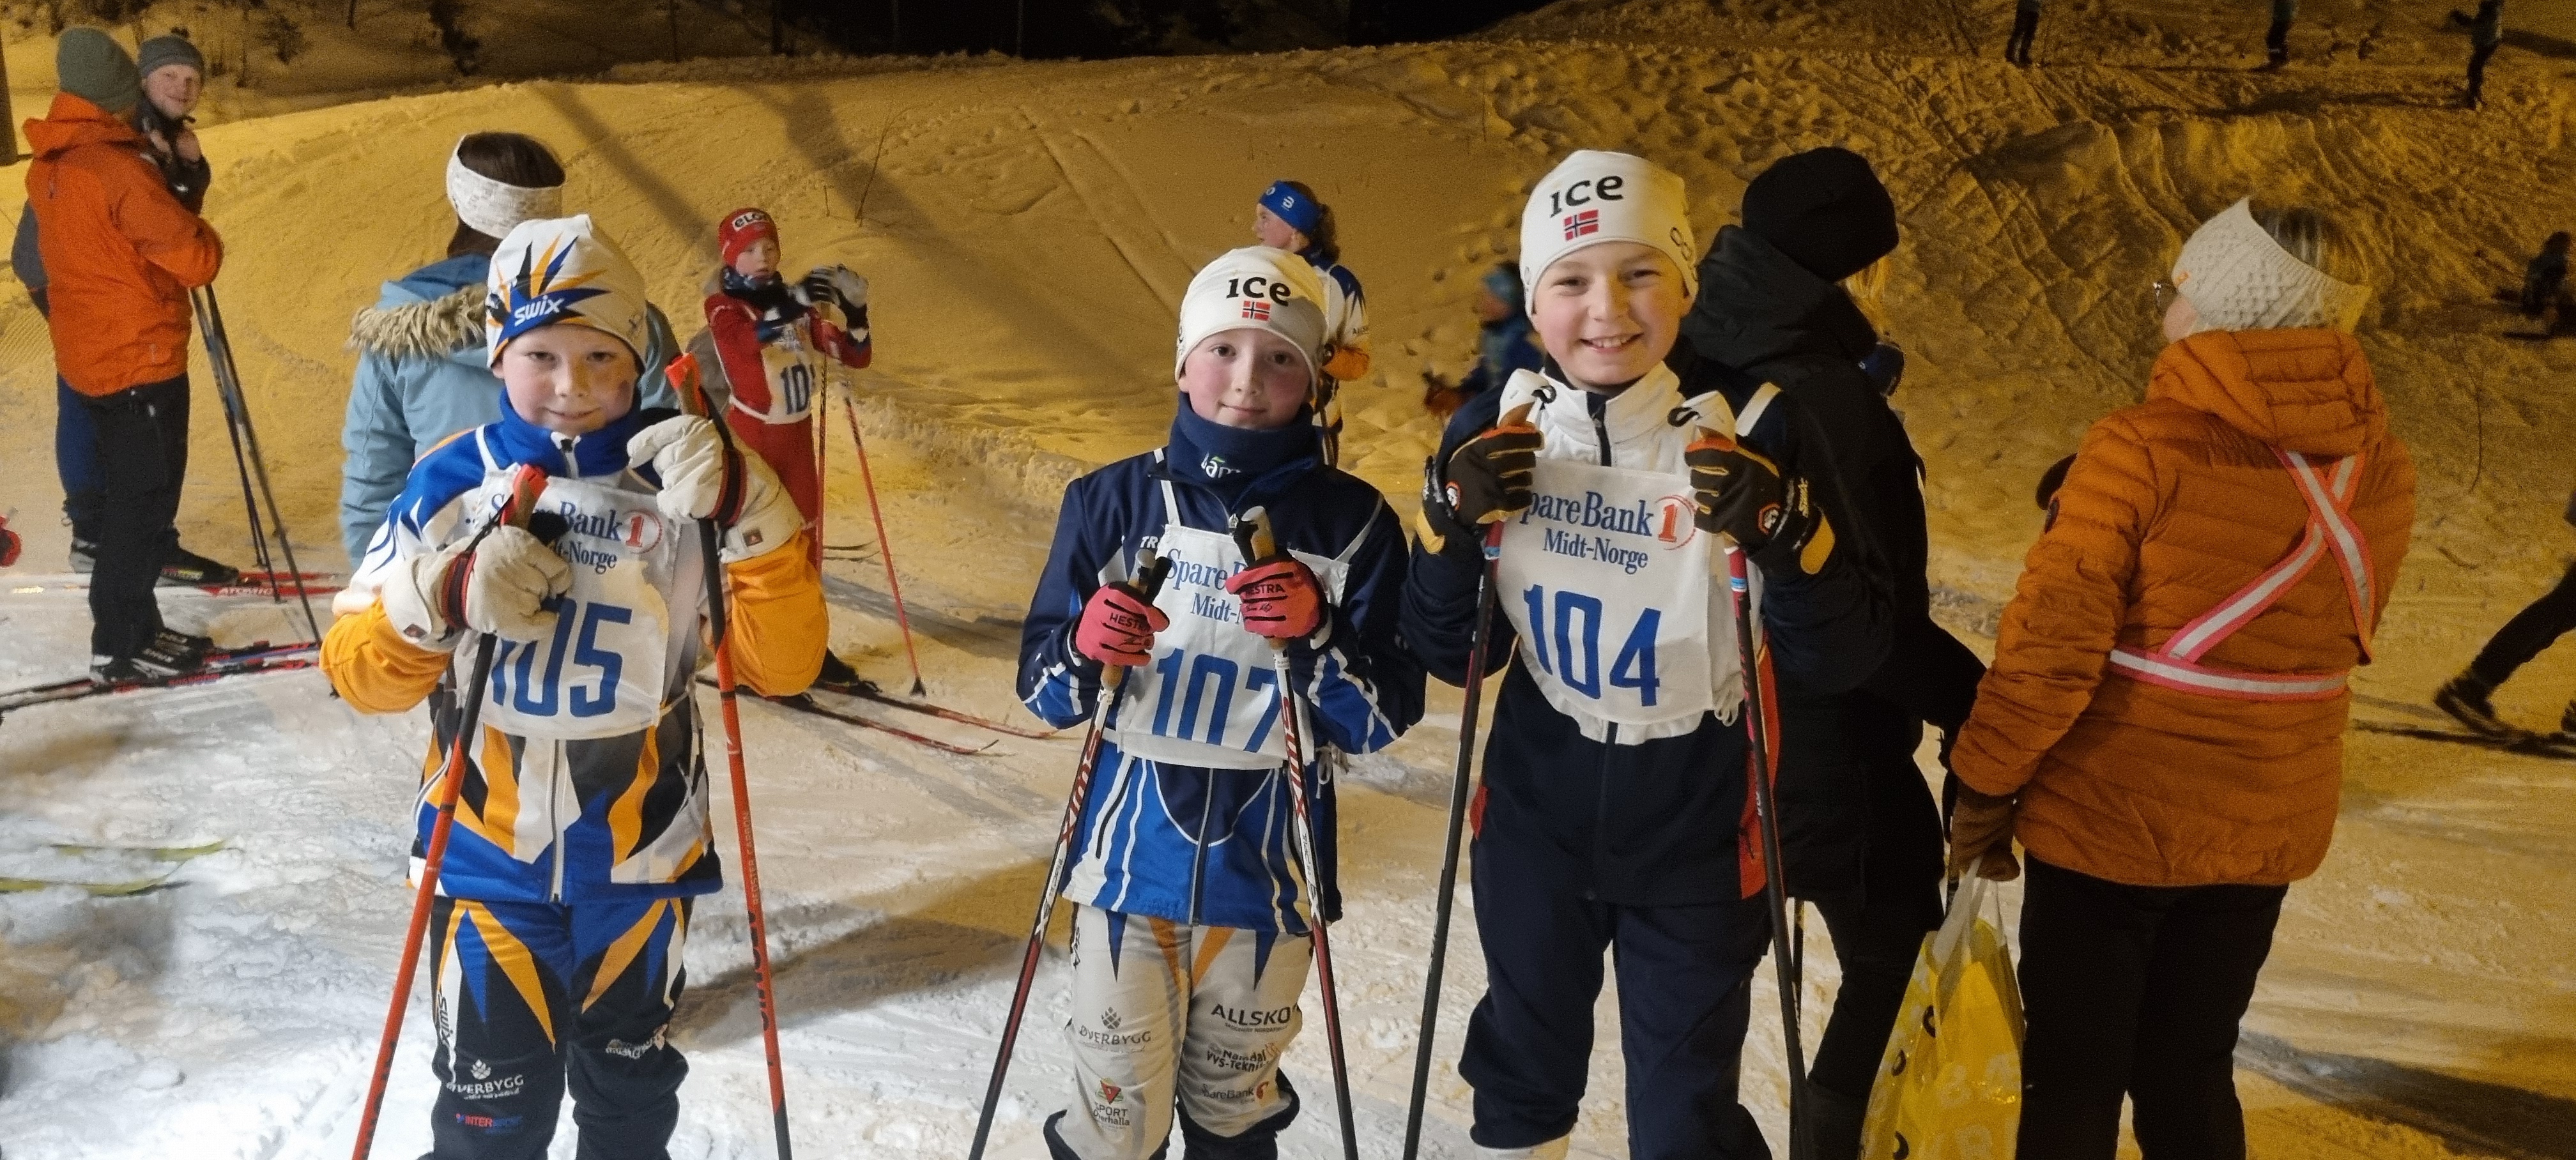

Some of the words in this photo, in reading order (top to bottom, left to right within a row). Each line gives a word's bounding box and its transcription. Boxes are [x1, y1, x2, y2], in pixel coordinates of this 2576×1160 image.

[1519, 491, 1655, 537] pareBank
[553, 540, 617, 574] t-Norge
[1542, 528, 1648, 575] Midt-Norge
[1190, 593, 1243, 625] Midt-
[491, 595, 633, 717] 105
[1523, 584, 1661, 707] 104
[1151, 648, 1283, 753] 107
